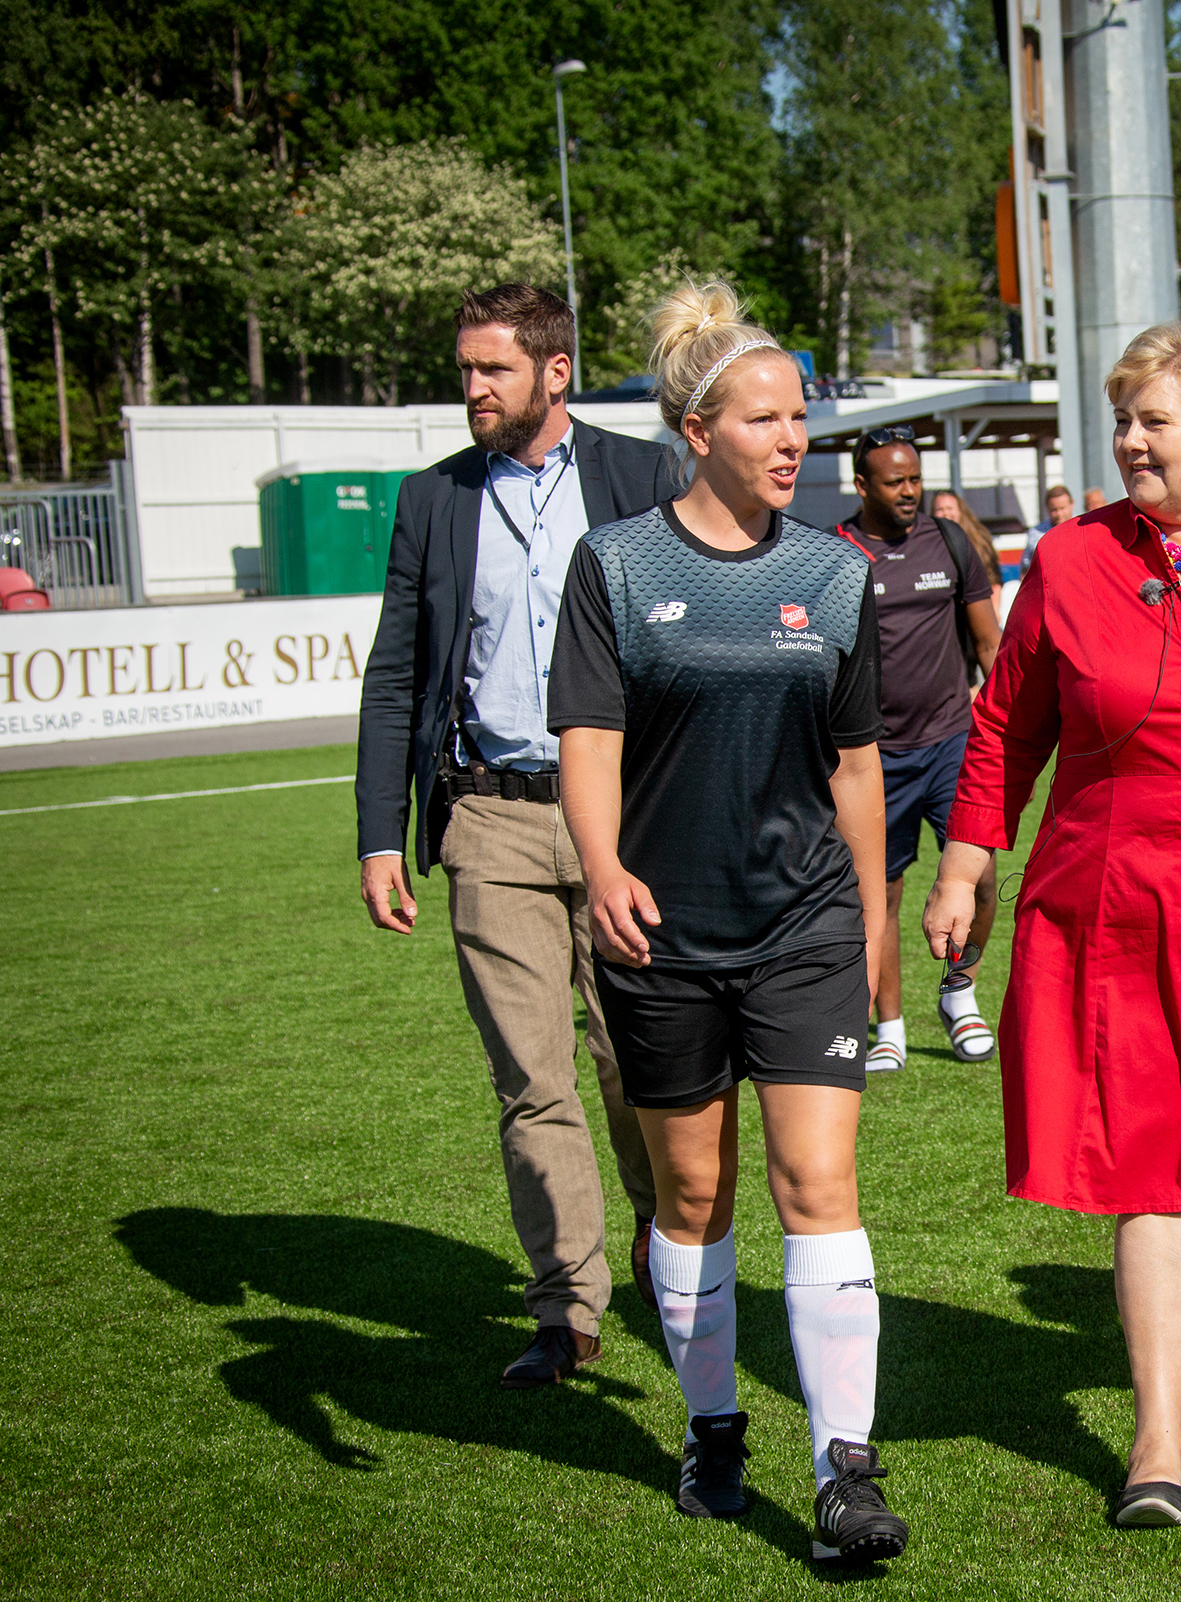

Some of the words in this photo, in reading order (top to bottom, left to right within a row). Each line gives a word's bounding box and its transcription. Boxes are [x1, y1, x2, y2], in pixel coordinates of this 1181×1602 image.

[919, 571, 946, 581] TEAM
[914, 578, 951, 591] NORWAY
[770, 630, 783, 639] FA
[784, 630, 824, 643] Sandvika
[775, 640, 823, 653] Gatefotball
[0, 641, 207, 703] HOTELL
[222, 639, 254, 688] &
[273, 632, 362, 685] SPA
[102, 699, 263, 727] BAR/RESTAURANT
